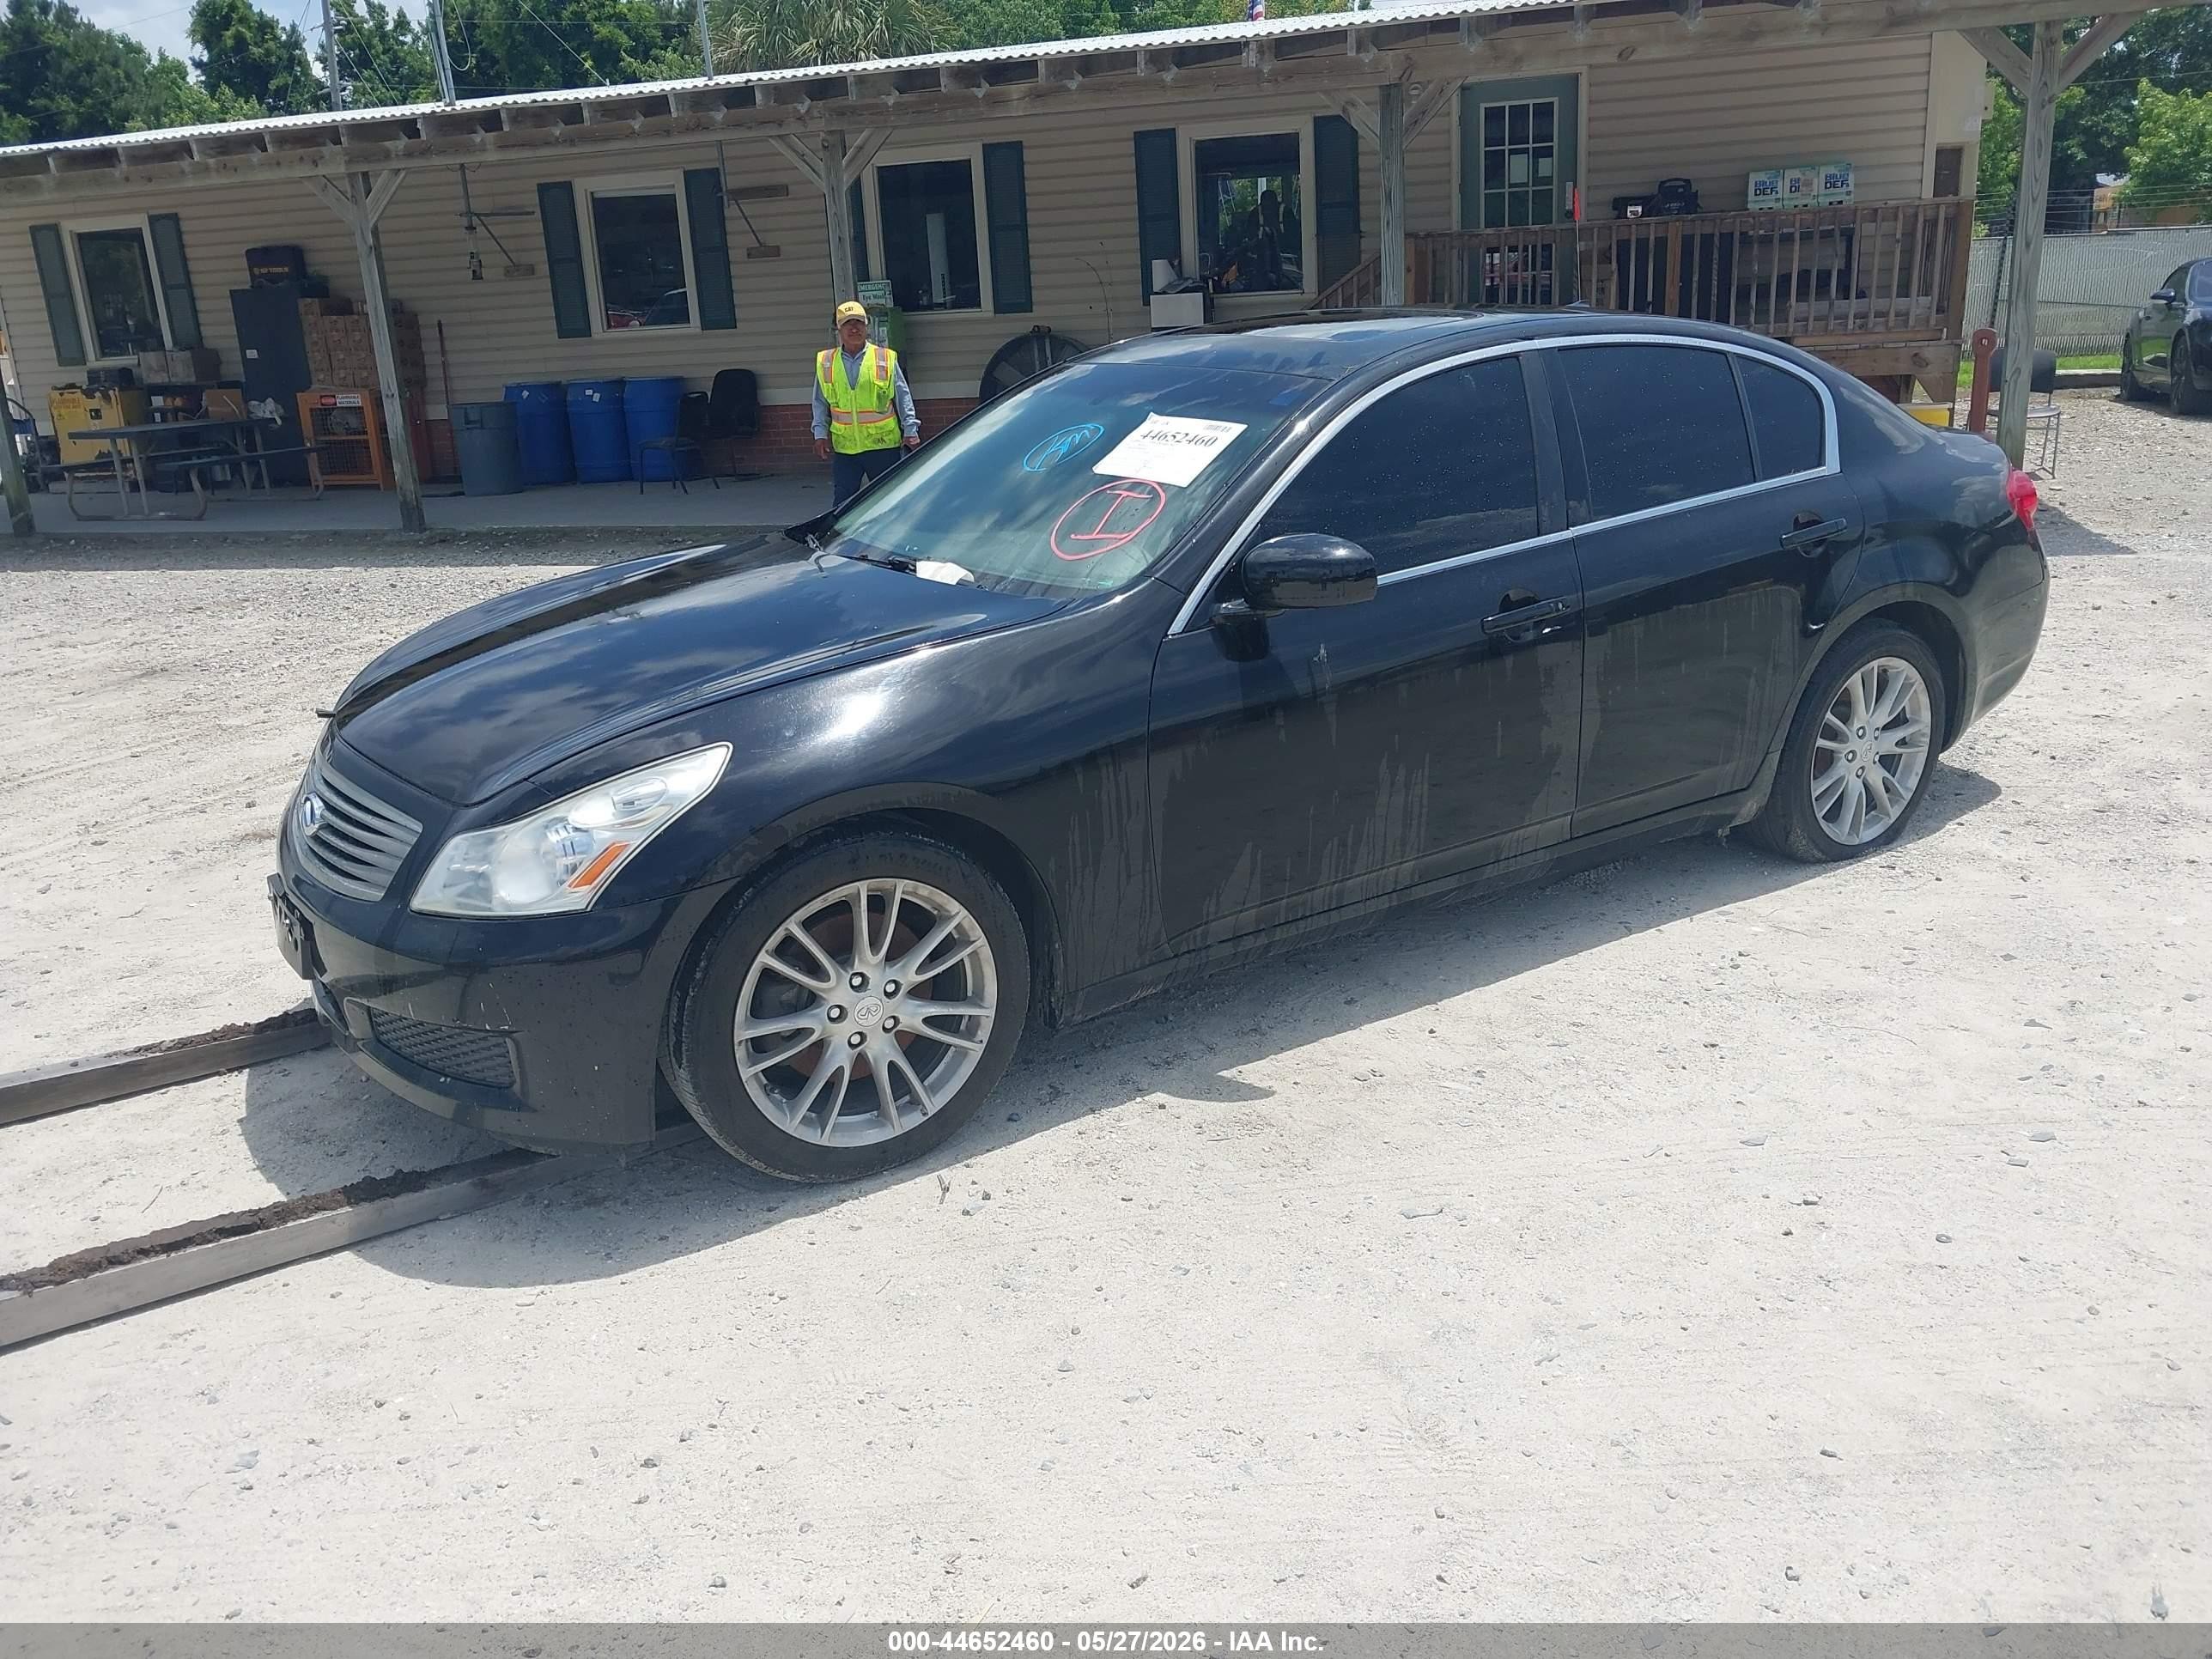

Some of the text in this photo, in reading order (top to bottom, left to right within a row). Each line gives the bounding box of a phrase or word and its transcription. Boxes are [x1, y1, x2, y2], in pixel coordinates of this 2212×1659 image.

[1824, 179, 1849, 189] DEF
[1754, 186, 1778, 196] DEF
[1140, 428, 1218, 447] 44652460
